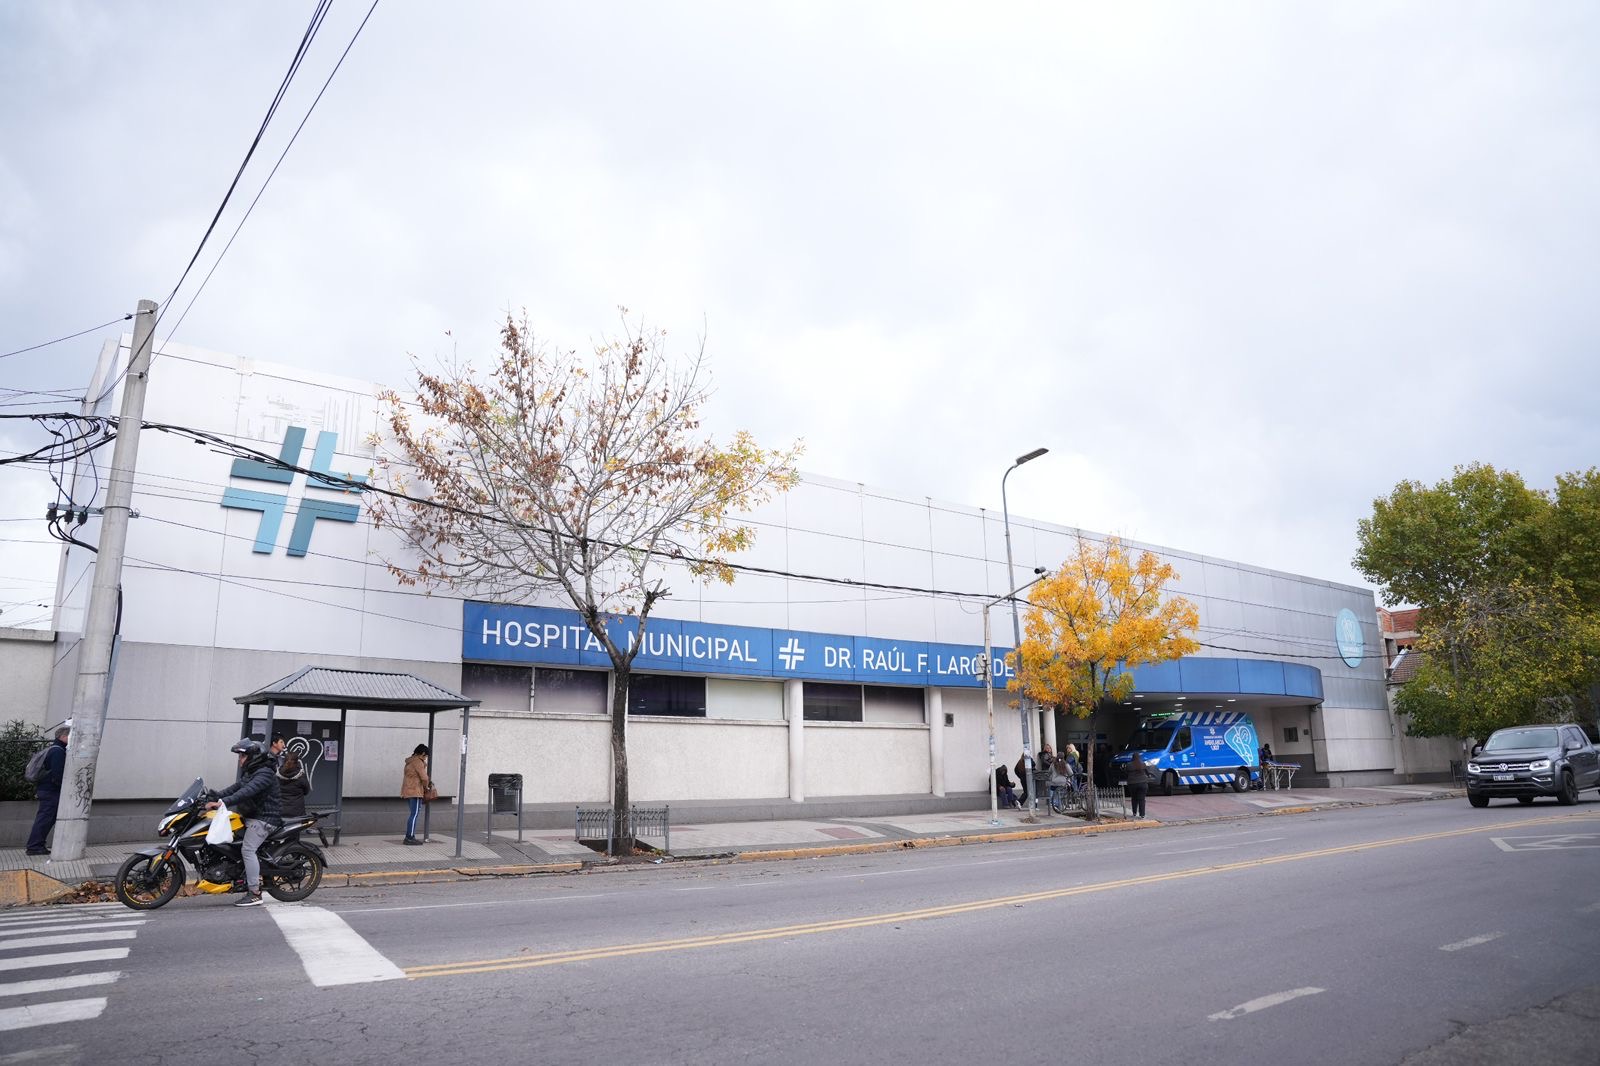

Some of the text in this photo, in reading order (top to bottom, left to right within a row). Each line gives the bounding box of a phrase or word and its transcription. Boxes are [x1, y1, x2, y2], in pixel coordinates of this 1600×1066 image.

[482, 619, 610, 653] HOSPITA
[627, 630, 758, 662] MUNICIPAL
[824, 646, 855, 669] DR.
[862, 646, 912, 674] RAÚL
[917, 653, 931, 674] F.
